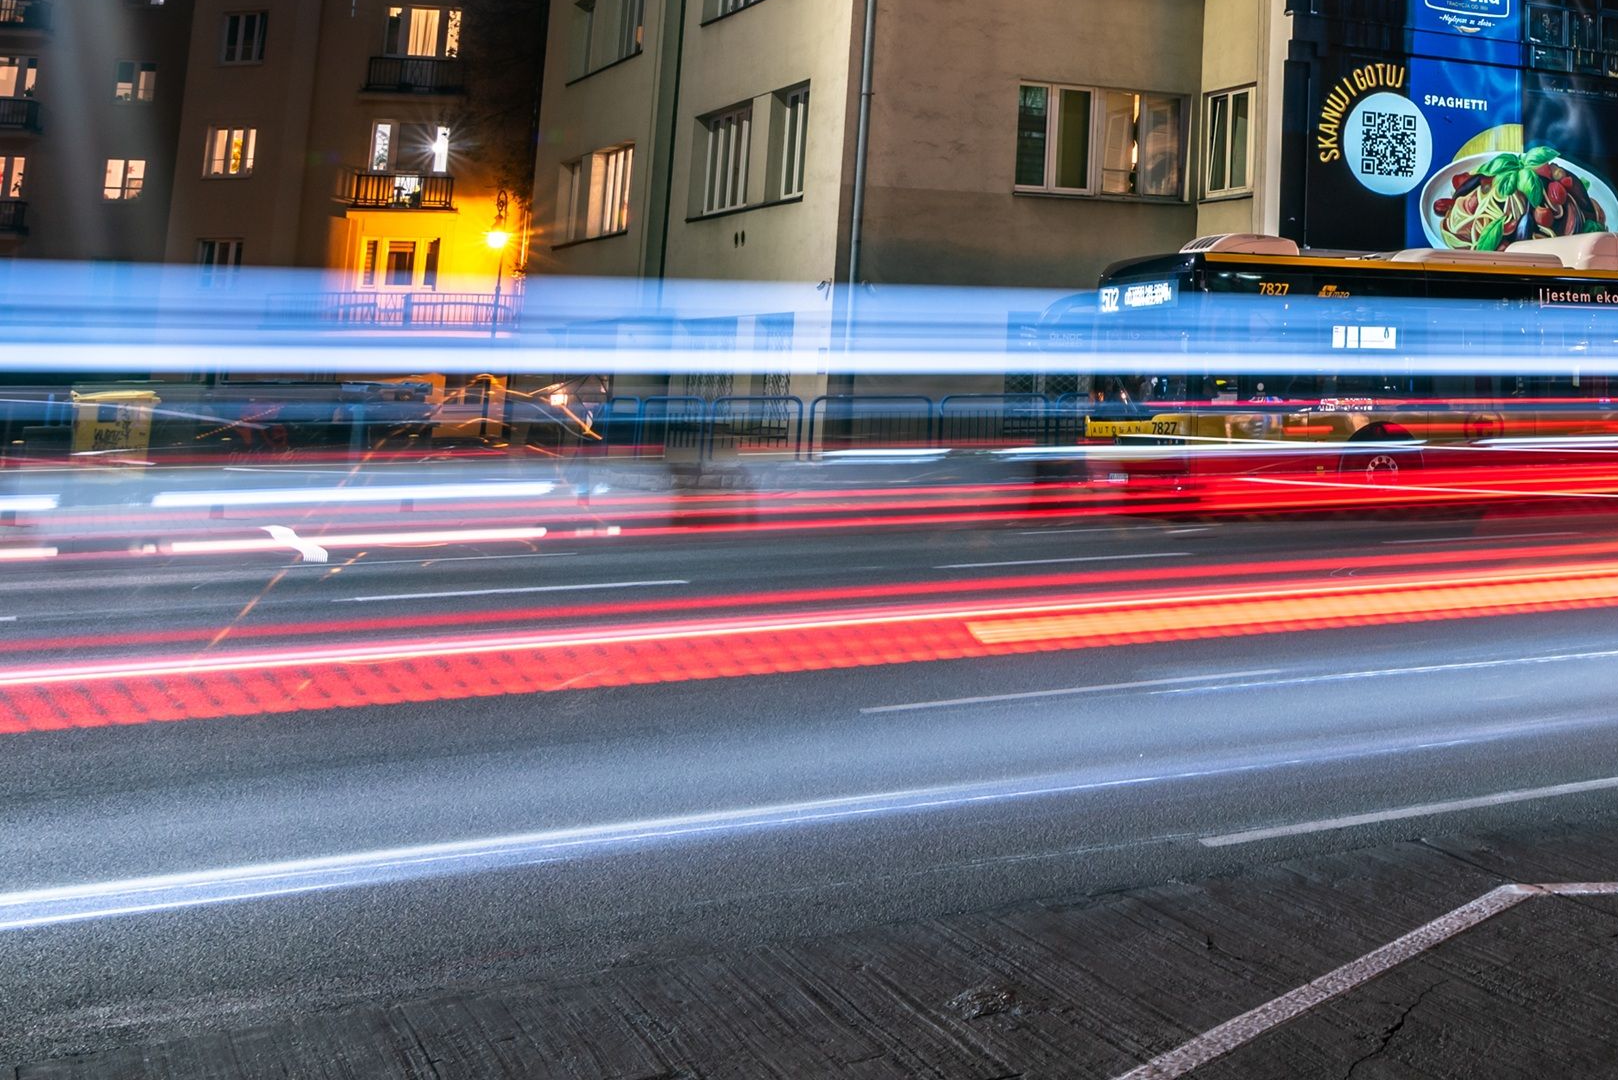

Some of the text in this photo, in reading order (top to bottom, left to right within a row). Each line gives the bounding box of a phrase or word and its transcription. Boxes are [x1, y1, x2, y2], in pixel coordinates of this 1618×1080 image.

[1424, 94, 1488, 112] SPAGHETTI
[1317, 63, 1405, 162] SKANUJ I GOTUJ
[1258, 282, 1290, 297] 7827
[1546, 287, 1591, 305] jestem
[1101, 287, 1120, 313] 502
[1092, 421, 1178, 435] AUTOSAN 7827
